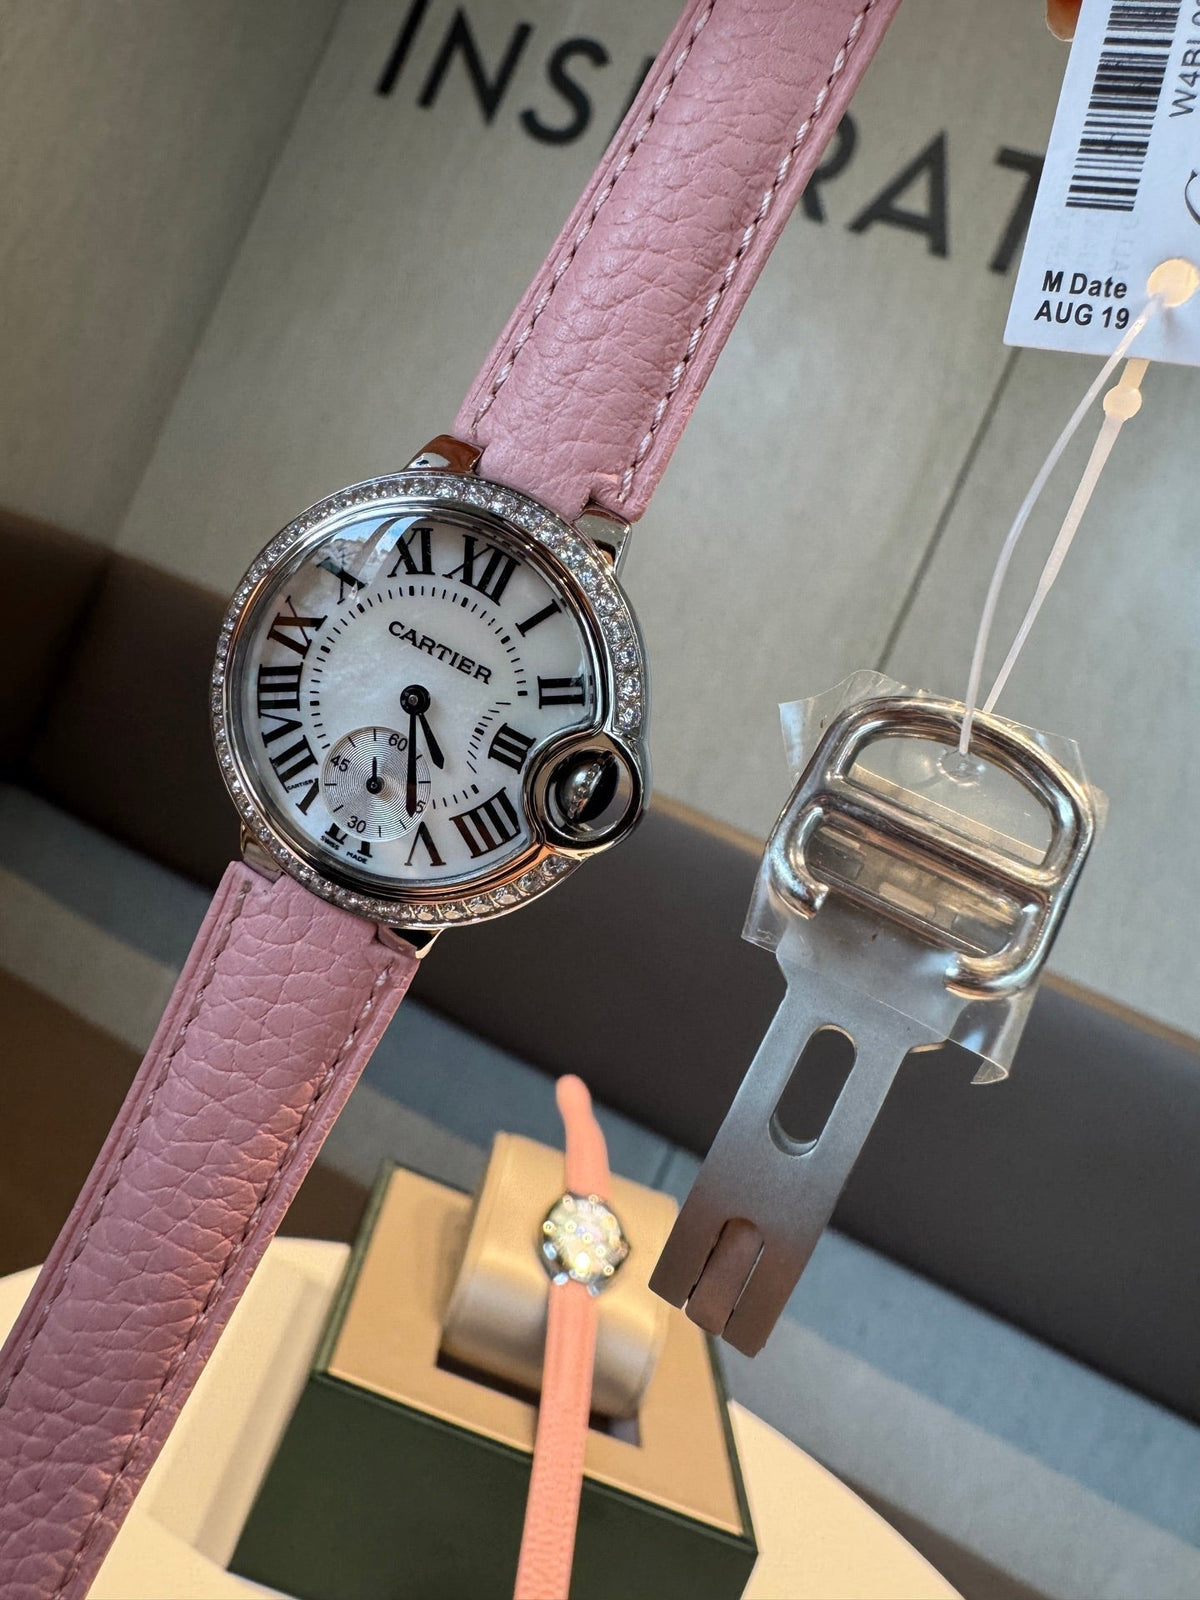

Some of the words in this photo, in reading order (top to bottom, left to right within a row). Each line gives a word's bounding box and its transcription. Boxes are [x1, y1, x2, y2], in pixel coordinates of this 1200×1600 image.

[1041, 270, 1064, 293] M
[1069, 272, 1128, 299] Date
[1033, 300, 1093, 326] AUG
[1101, 306, 1130, 330] 19
[387, 527, 436, 578] XI
[442, 534, 521, 606] XII
[266, 595, 328, 660] IX
[388, 620, 492, 685] CARTIER
[257, 663, 303, 748] VIII
[537, 673, 585, 709] II
[330, 755, 350, 772] 45
[388, 733, 408, 752] 60
[488, 722, 536, 774] III
[347, 815, 367, 833] 30
[404, 821, 446, 867] V
[449, 786, 521, 859] IIII
